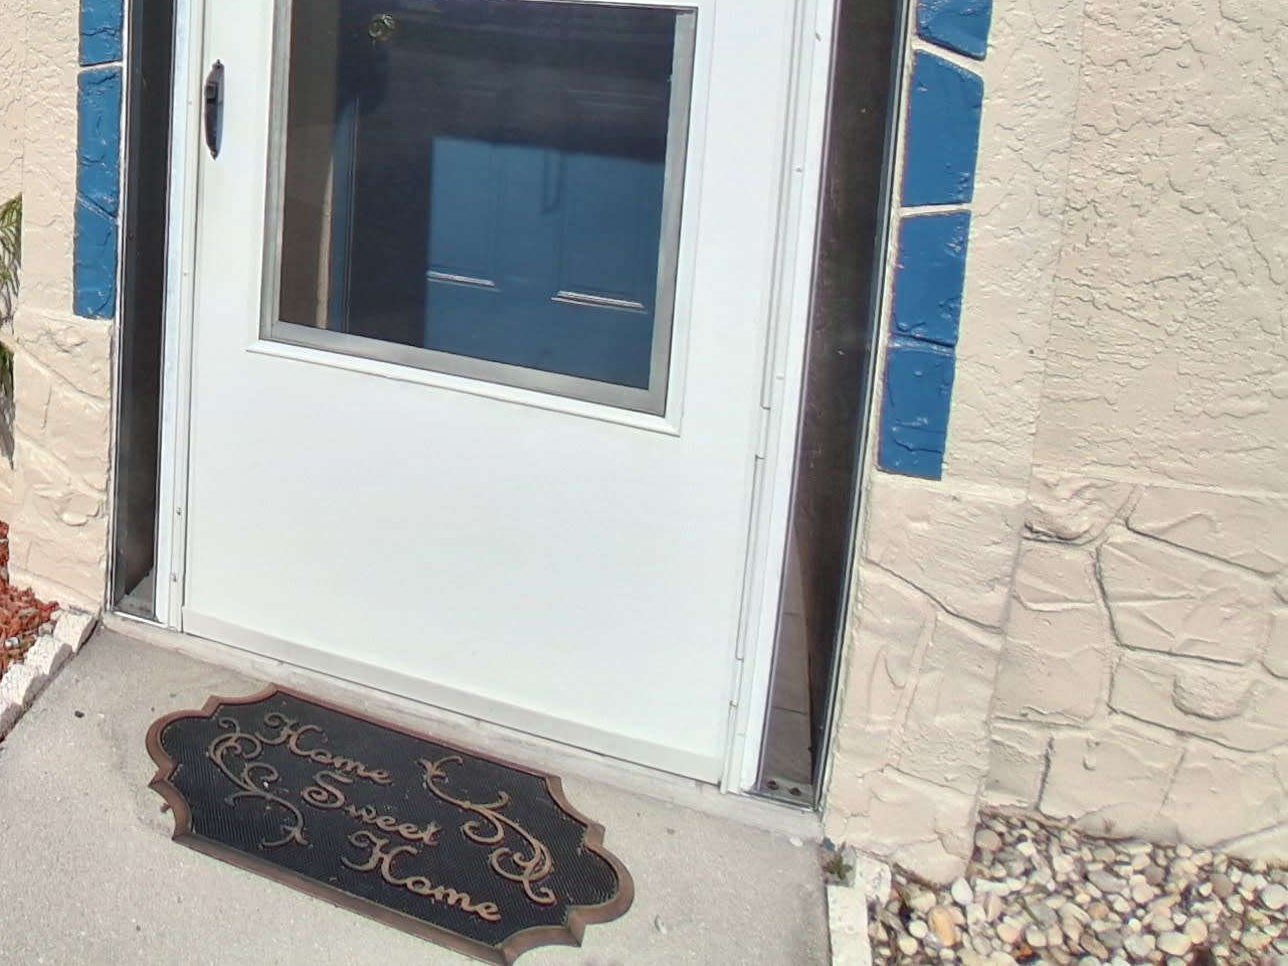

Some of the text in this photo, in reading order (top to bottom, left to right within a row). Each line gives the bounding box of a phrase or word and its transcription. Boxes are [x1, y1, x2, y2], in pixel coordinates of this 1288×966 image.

[256, 712, 392, 785] Home
[301, 769, 441, 845] Sweet
[342, 830, 502, 922] Home
